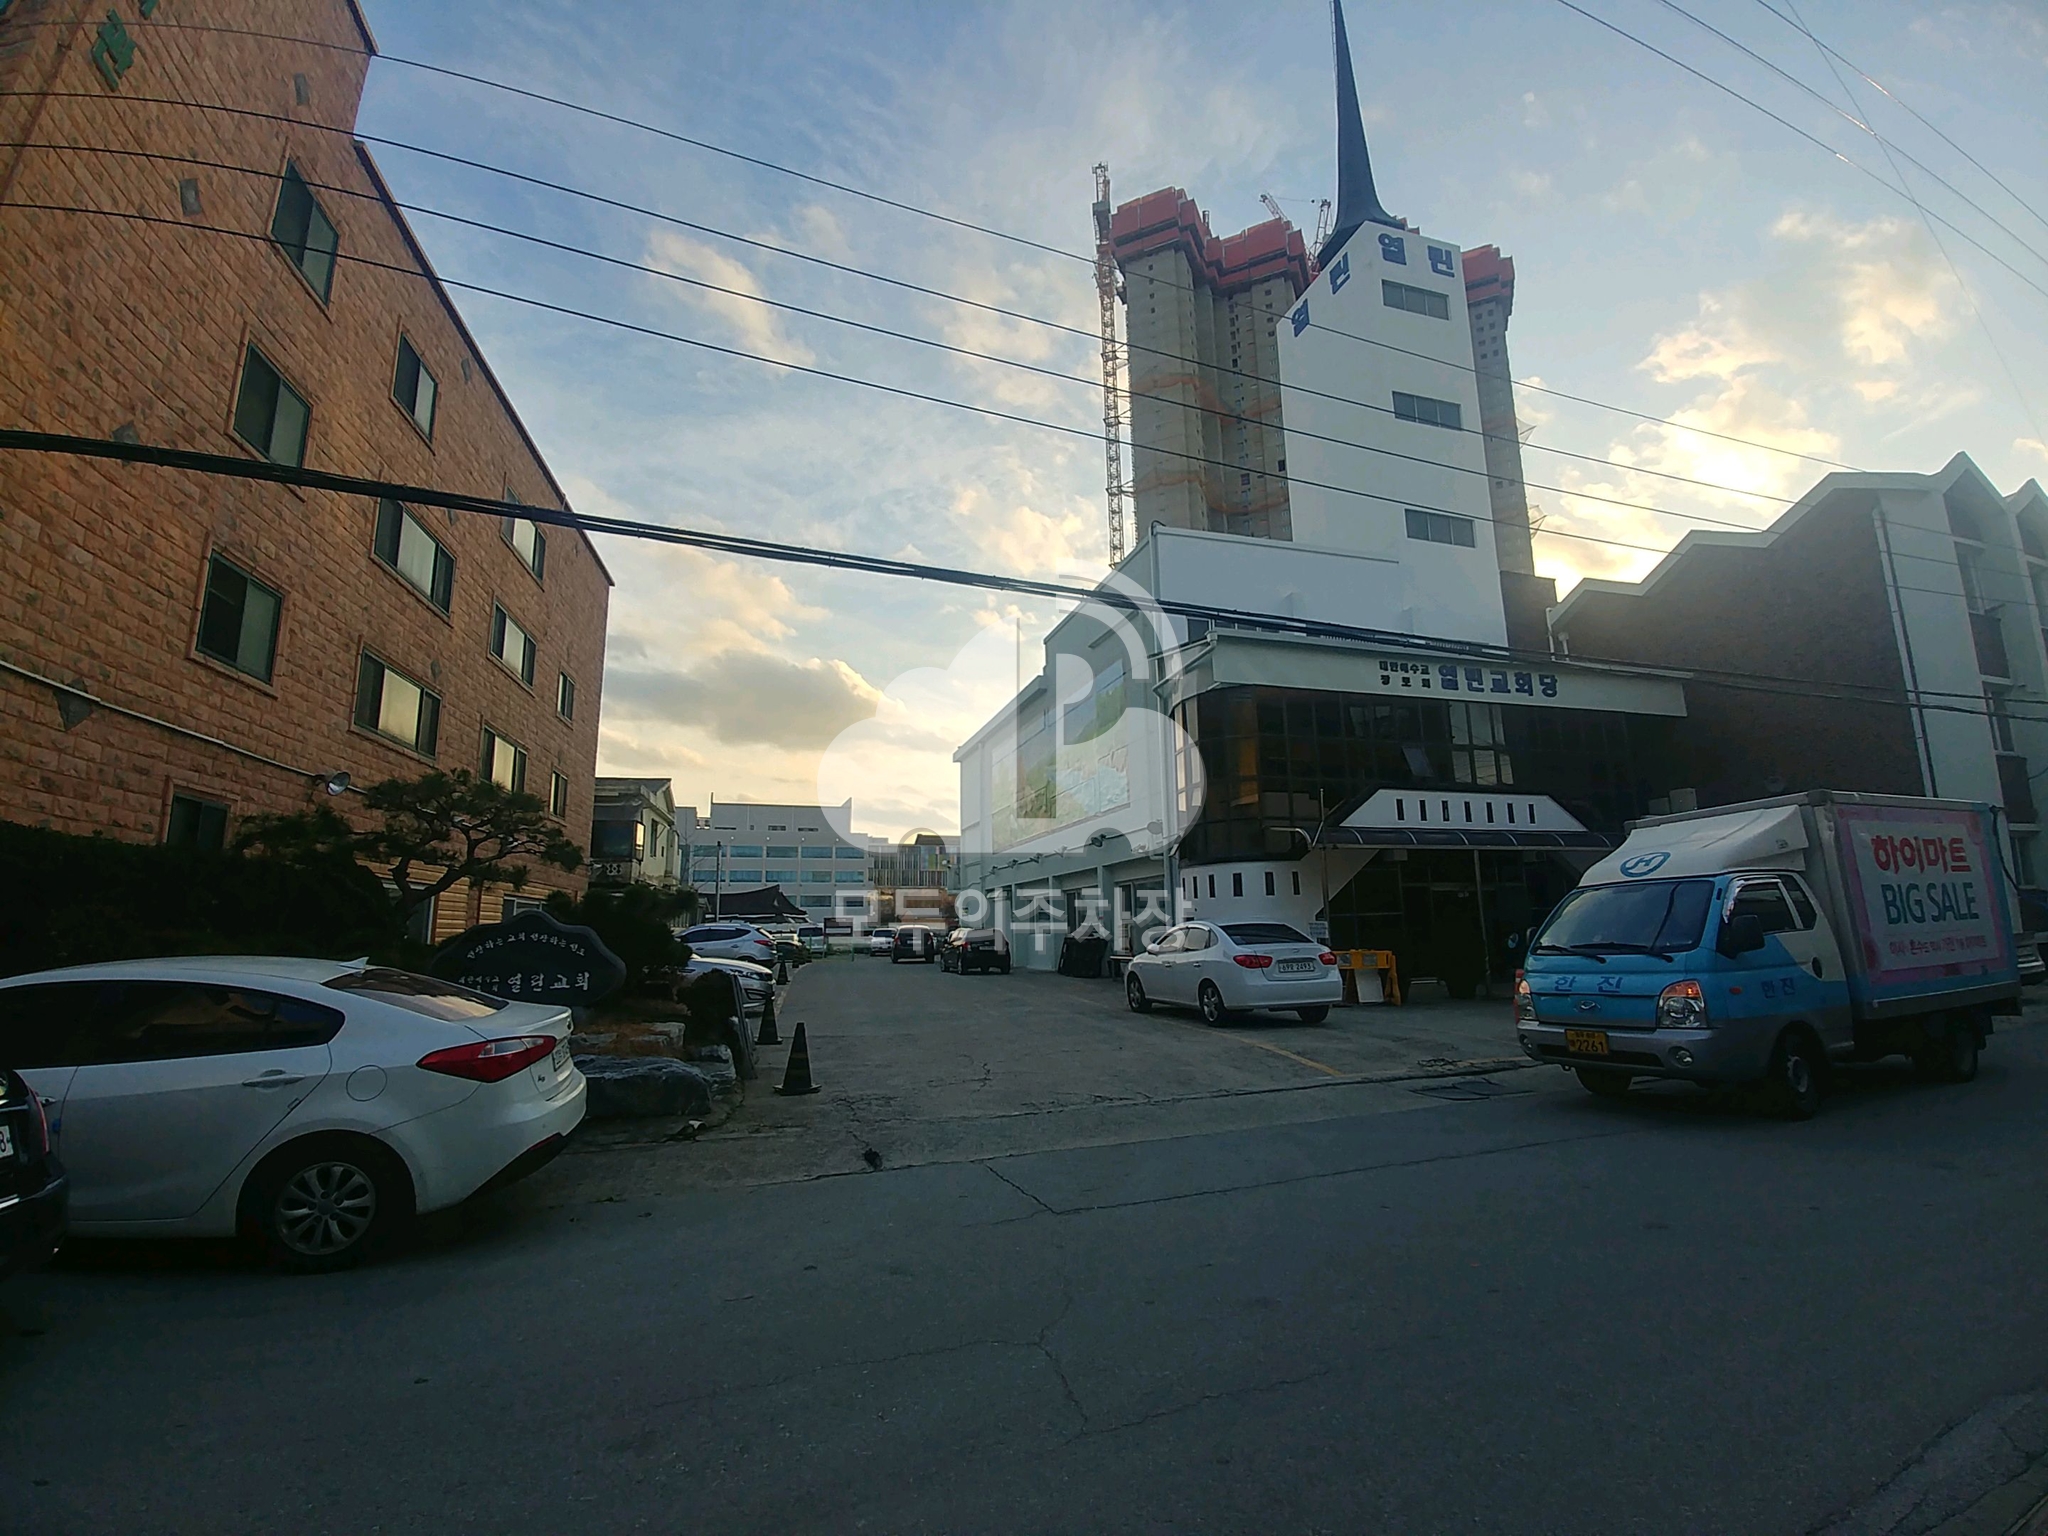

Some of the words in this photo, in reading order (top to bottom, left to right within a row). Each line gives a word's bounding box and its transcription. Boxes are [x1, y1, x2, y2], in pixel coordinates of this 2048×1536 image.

[1378, 232, 1455, 278] 열린
[1438, 665, 1558, 697] 열린교회당
[1870, 835, 1971, 874] 하이마트
[1881, 883, 1926, 925] BIG
[1927, 882, 1980, 922] SALE
[1554, 976, 1623, 993] 한진
[1761, 977, 1796, 999] 한진
